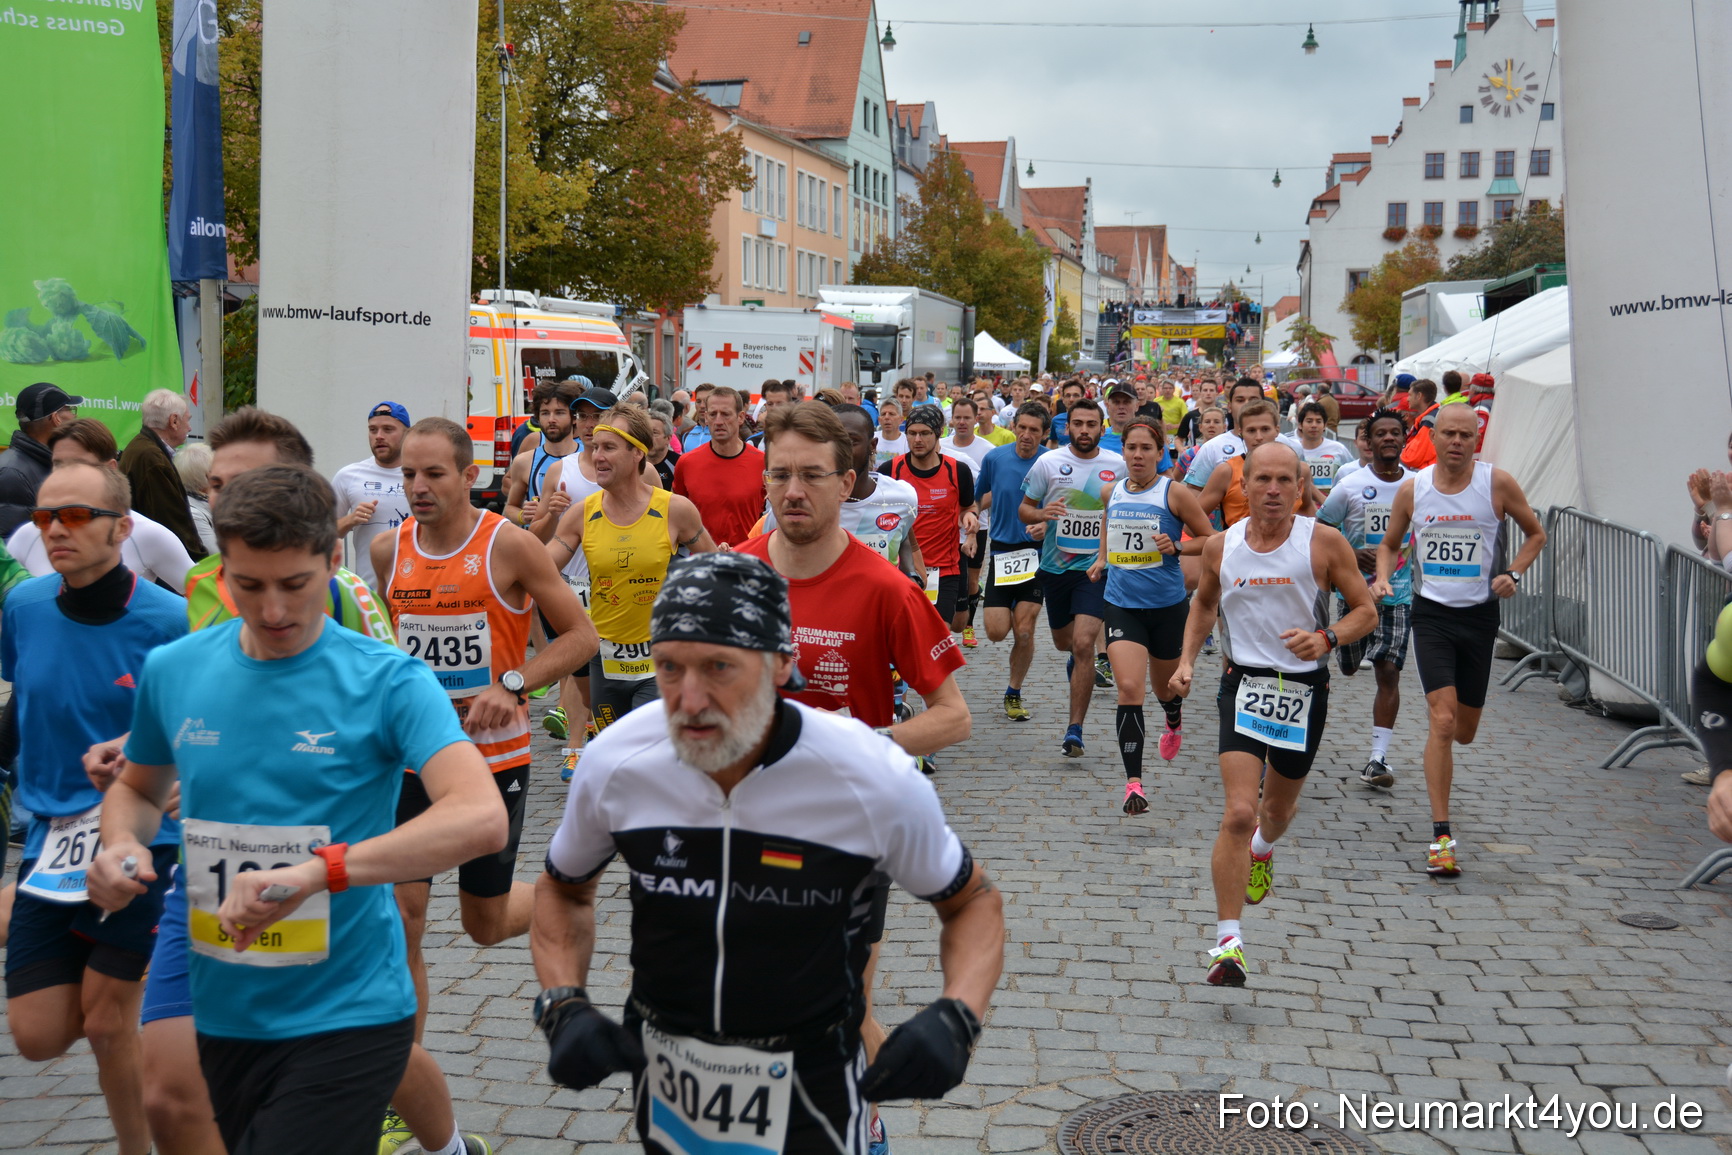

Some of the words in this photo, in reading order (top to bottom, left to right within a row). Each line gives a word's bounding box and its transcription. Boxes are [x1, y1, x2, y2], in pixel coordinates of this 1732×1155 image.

[262, 304, 431, 326] www.bmw-laufsport.de
[1161, 328, 1194, 337] START
[743, 344, 787, 352] Bayerisches
[1136, 512, 1161, 520] FINANZ
[1062, 519, 1100, 537] 3086
[1122, 532, 1144, 550] 73
[1426, 541, 1476, 562] 2657
[1004, 558, 1030, 575] 527
[1440, 567, 1461, 575] Peter
[1249, 577, 1295, 585] KLEBL
[464, 600, 485, 608] BKK
[400, 622, 426, 632] PARTL
[428, 624, 472, 632] Neumarkt
[796, 626, 856, 640] NEUMARKTER
[793, 634, 843, 647] STADTLAUF
[406, 635, 483, 667] 2435
[620, 663, 650, 673] Speedy
[1242, 681, 1265, 690] PARTL
[1267, 684, 1302, 695] Neumarkt
[1244, 692, 1304, 723] 2552
[1252, 720, 1288, 738] Berthold
[186, 834, 227, 850] PARTL
[230, 840, 302, 854] Neumarkt
[654, 855, 687, 868] Nalini
[731, 882, 842, 906] NALINI
[645, 1025, 682, 1058] PARTL
[685, 1051, 761, 1076] Neumarkt
[657, 1054, 772, 1137] 3044
